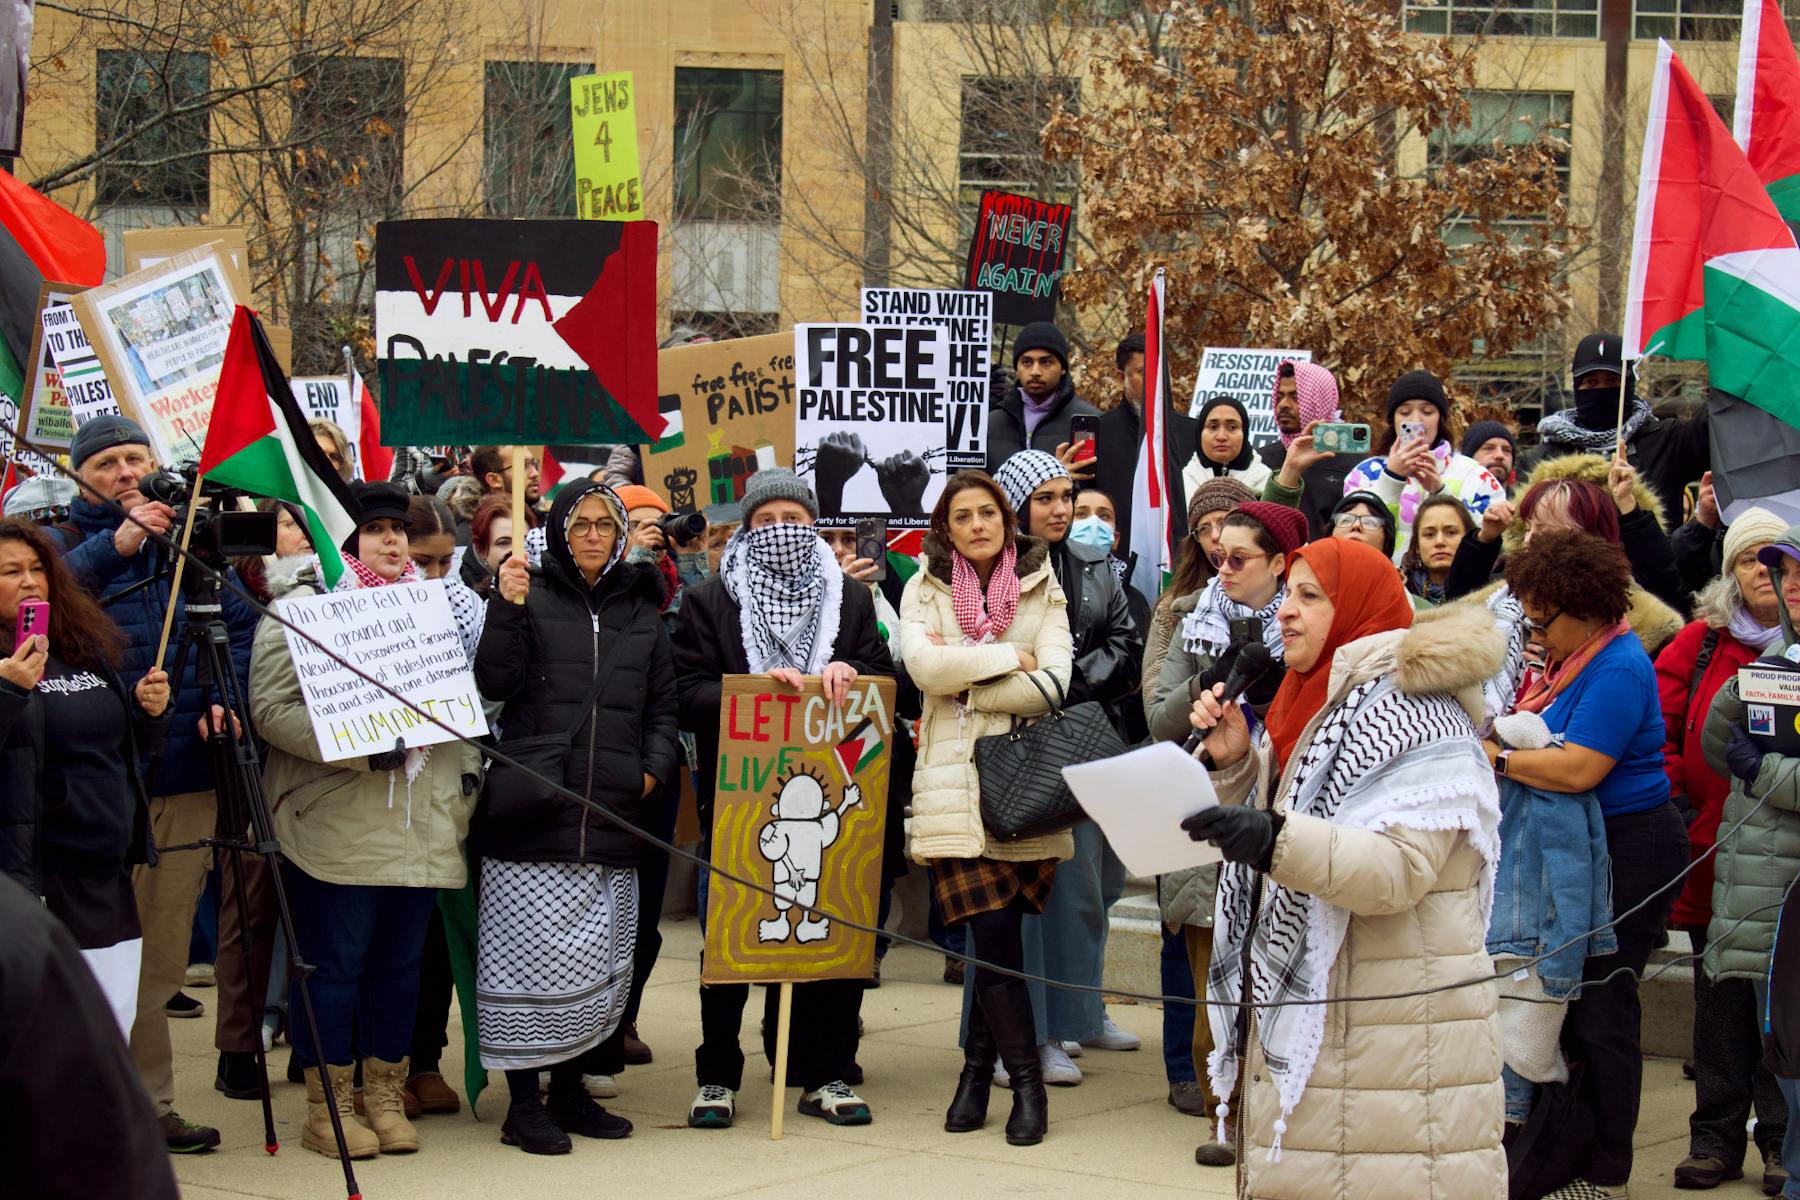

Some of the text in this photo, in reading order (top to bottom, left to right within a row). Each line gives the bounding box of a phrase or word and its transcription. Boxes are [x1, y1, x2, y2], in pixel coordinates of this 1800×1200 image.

[574, 79, 630, 118] JEWS
[593, 120, 614, 164] 4
[577, 176, 641, 220] PEACE
[402, 254, 554, 325] VIVA
[865, 290, 988, 317] STAND WITH
[43, 310, 69, 328] FROM
[48, 331, 65, 353] TO
[807, 327, 937, 390] FREE
[769, 354, 796, 372] fre
[1214, 372, 1278, 391] AGAINS
[305, 382, 339, 408] END
[387, 333, 620, 438] PALESTINA
[800, 389, 944, 423] PALESTINE
[949, 455, 984, 464] Liberation
[836, 516, 847, 525] for
[888, 517, 903, 526] and
[169, 524, 182, 562] Panaonic
[286, 602, 318, 625] An
[321, 595, 367, 624] apple
[372, 589, 402, 609] fell
[334, 618, 386, 658] ground
[388, 612, 416, 634] and
[418, 628, 460, 645] Gravity
[307, 646, 464, 700] Thousands of Palestinians
[339, 693, 363, 713] and
[362, 687, 385, 704] still
[401, 677, 423, 694] one
[425, 661, 470, 685] discovered
[1751, 671, 1776, 680] PROUD
[329, 693, 477, 752] HUMANITY
[728, 682, 891, 744] LET GAZA
[719, 746, 803, 792] LIVE
